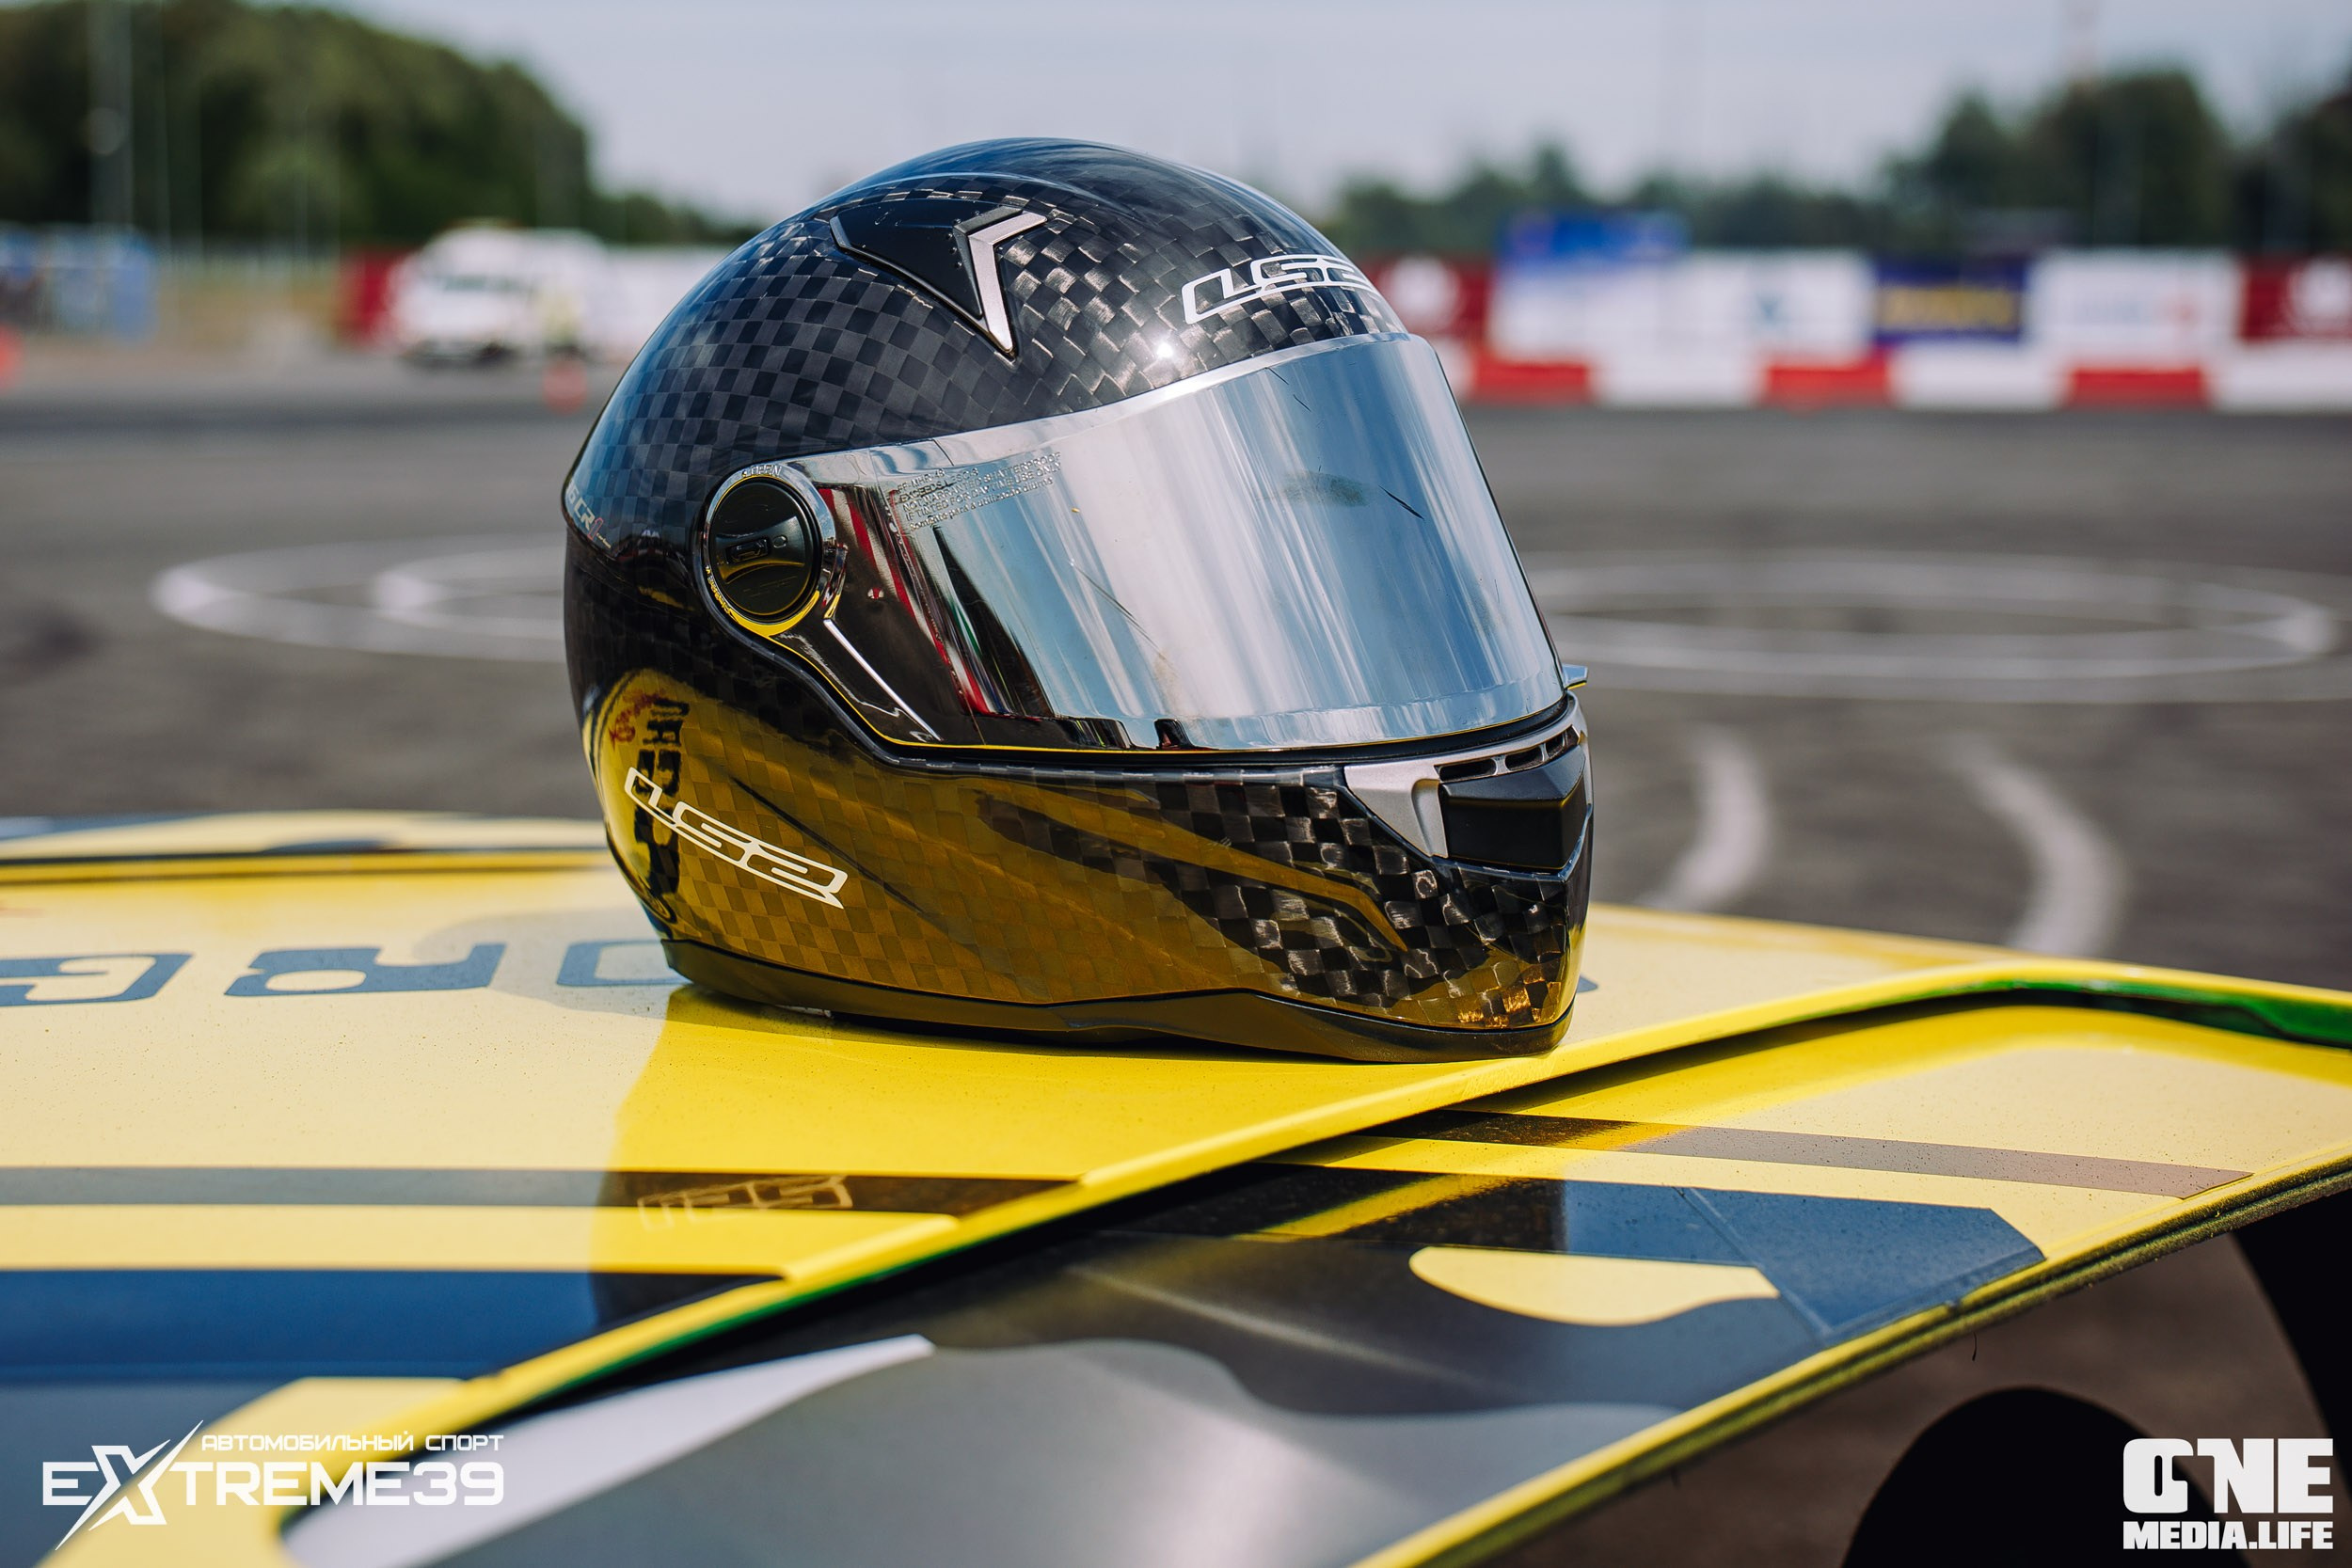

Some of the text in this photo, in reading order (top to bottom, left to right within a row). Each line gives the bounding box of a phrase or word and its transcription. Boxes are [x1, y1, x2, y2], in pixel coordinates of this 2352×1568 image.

[903, 451, 1060, 513] NOT WARRANTED SHATTERPROOF
[915, 499, 949, 517] TINTED
[950, 491, 972, 506] FOR
[625, 767, 848, 910] LS2
